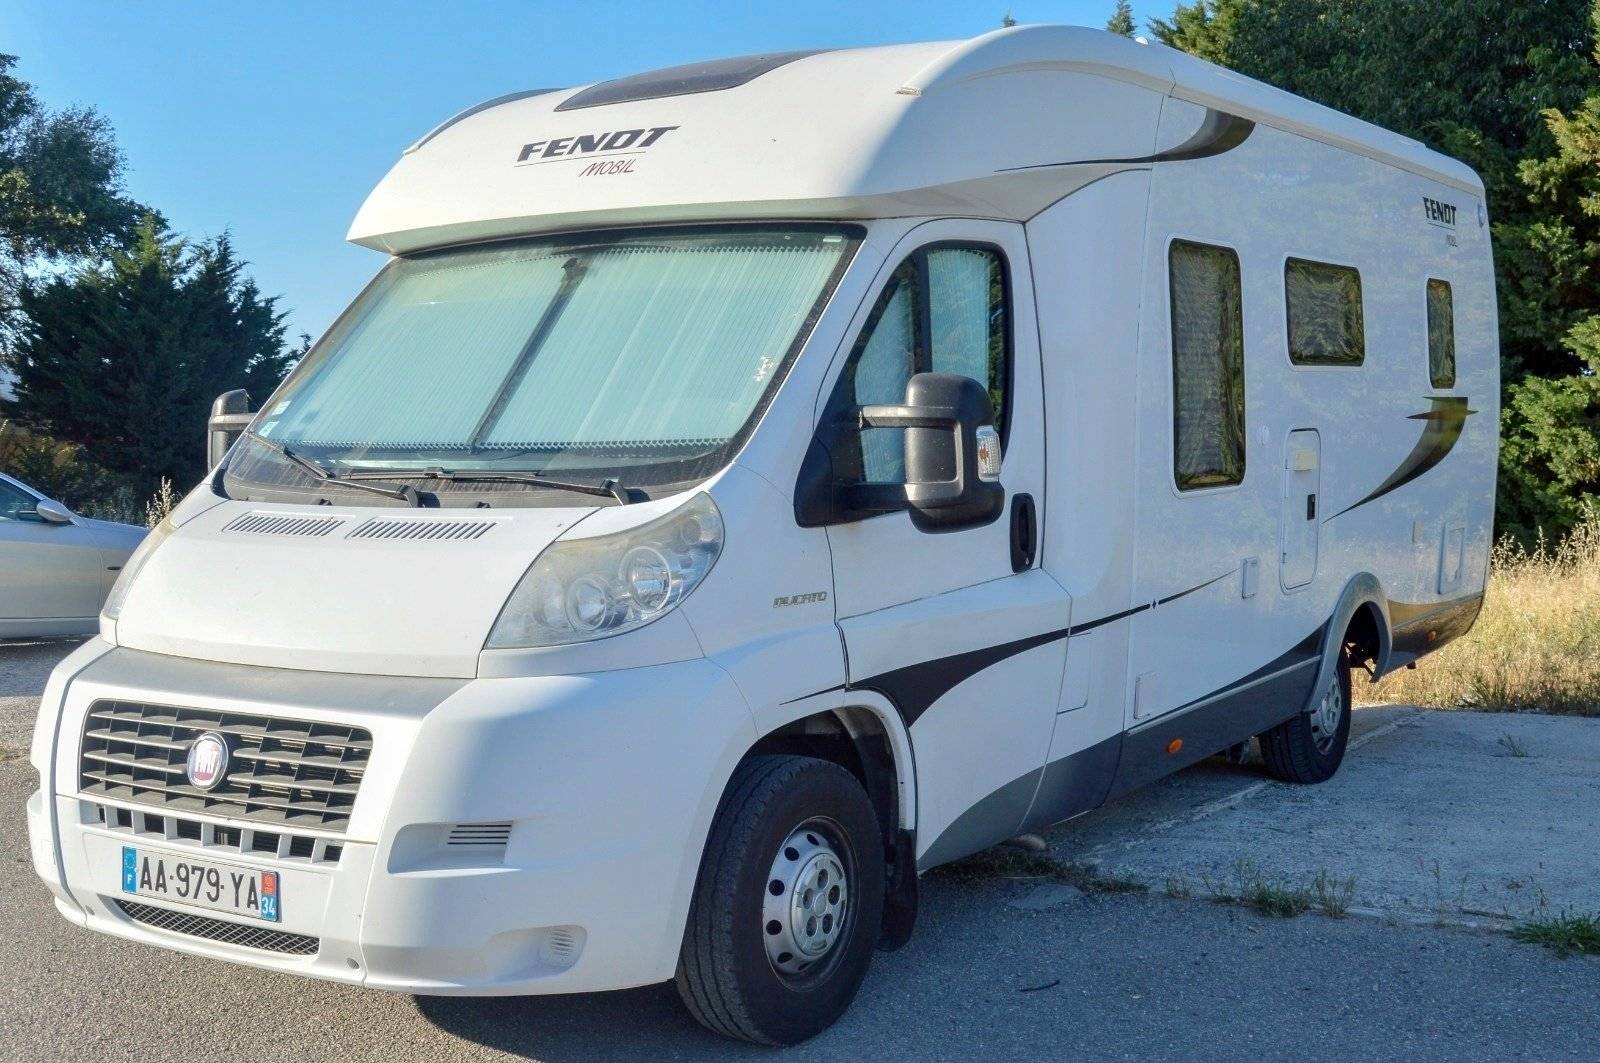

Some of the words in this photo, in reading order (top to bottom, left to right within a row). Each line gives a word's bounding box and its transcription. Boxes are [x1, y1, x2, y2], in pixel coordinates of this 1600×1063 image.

[517, 125, 681, 162] FENDT
[579, 159, 635, 177] MOBIL
[1422, 196, 1457, 226] FENDT
[261, 896, 276, 916] 34
